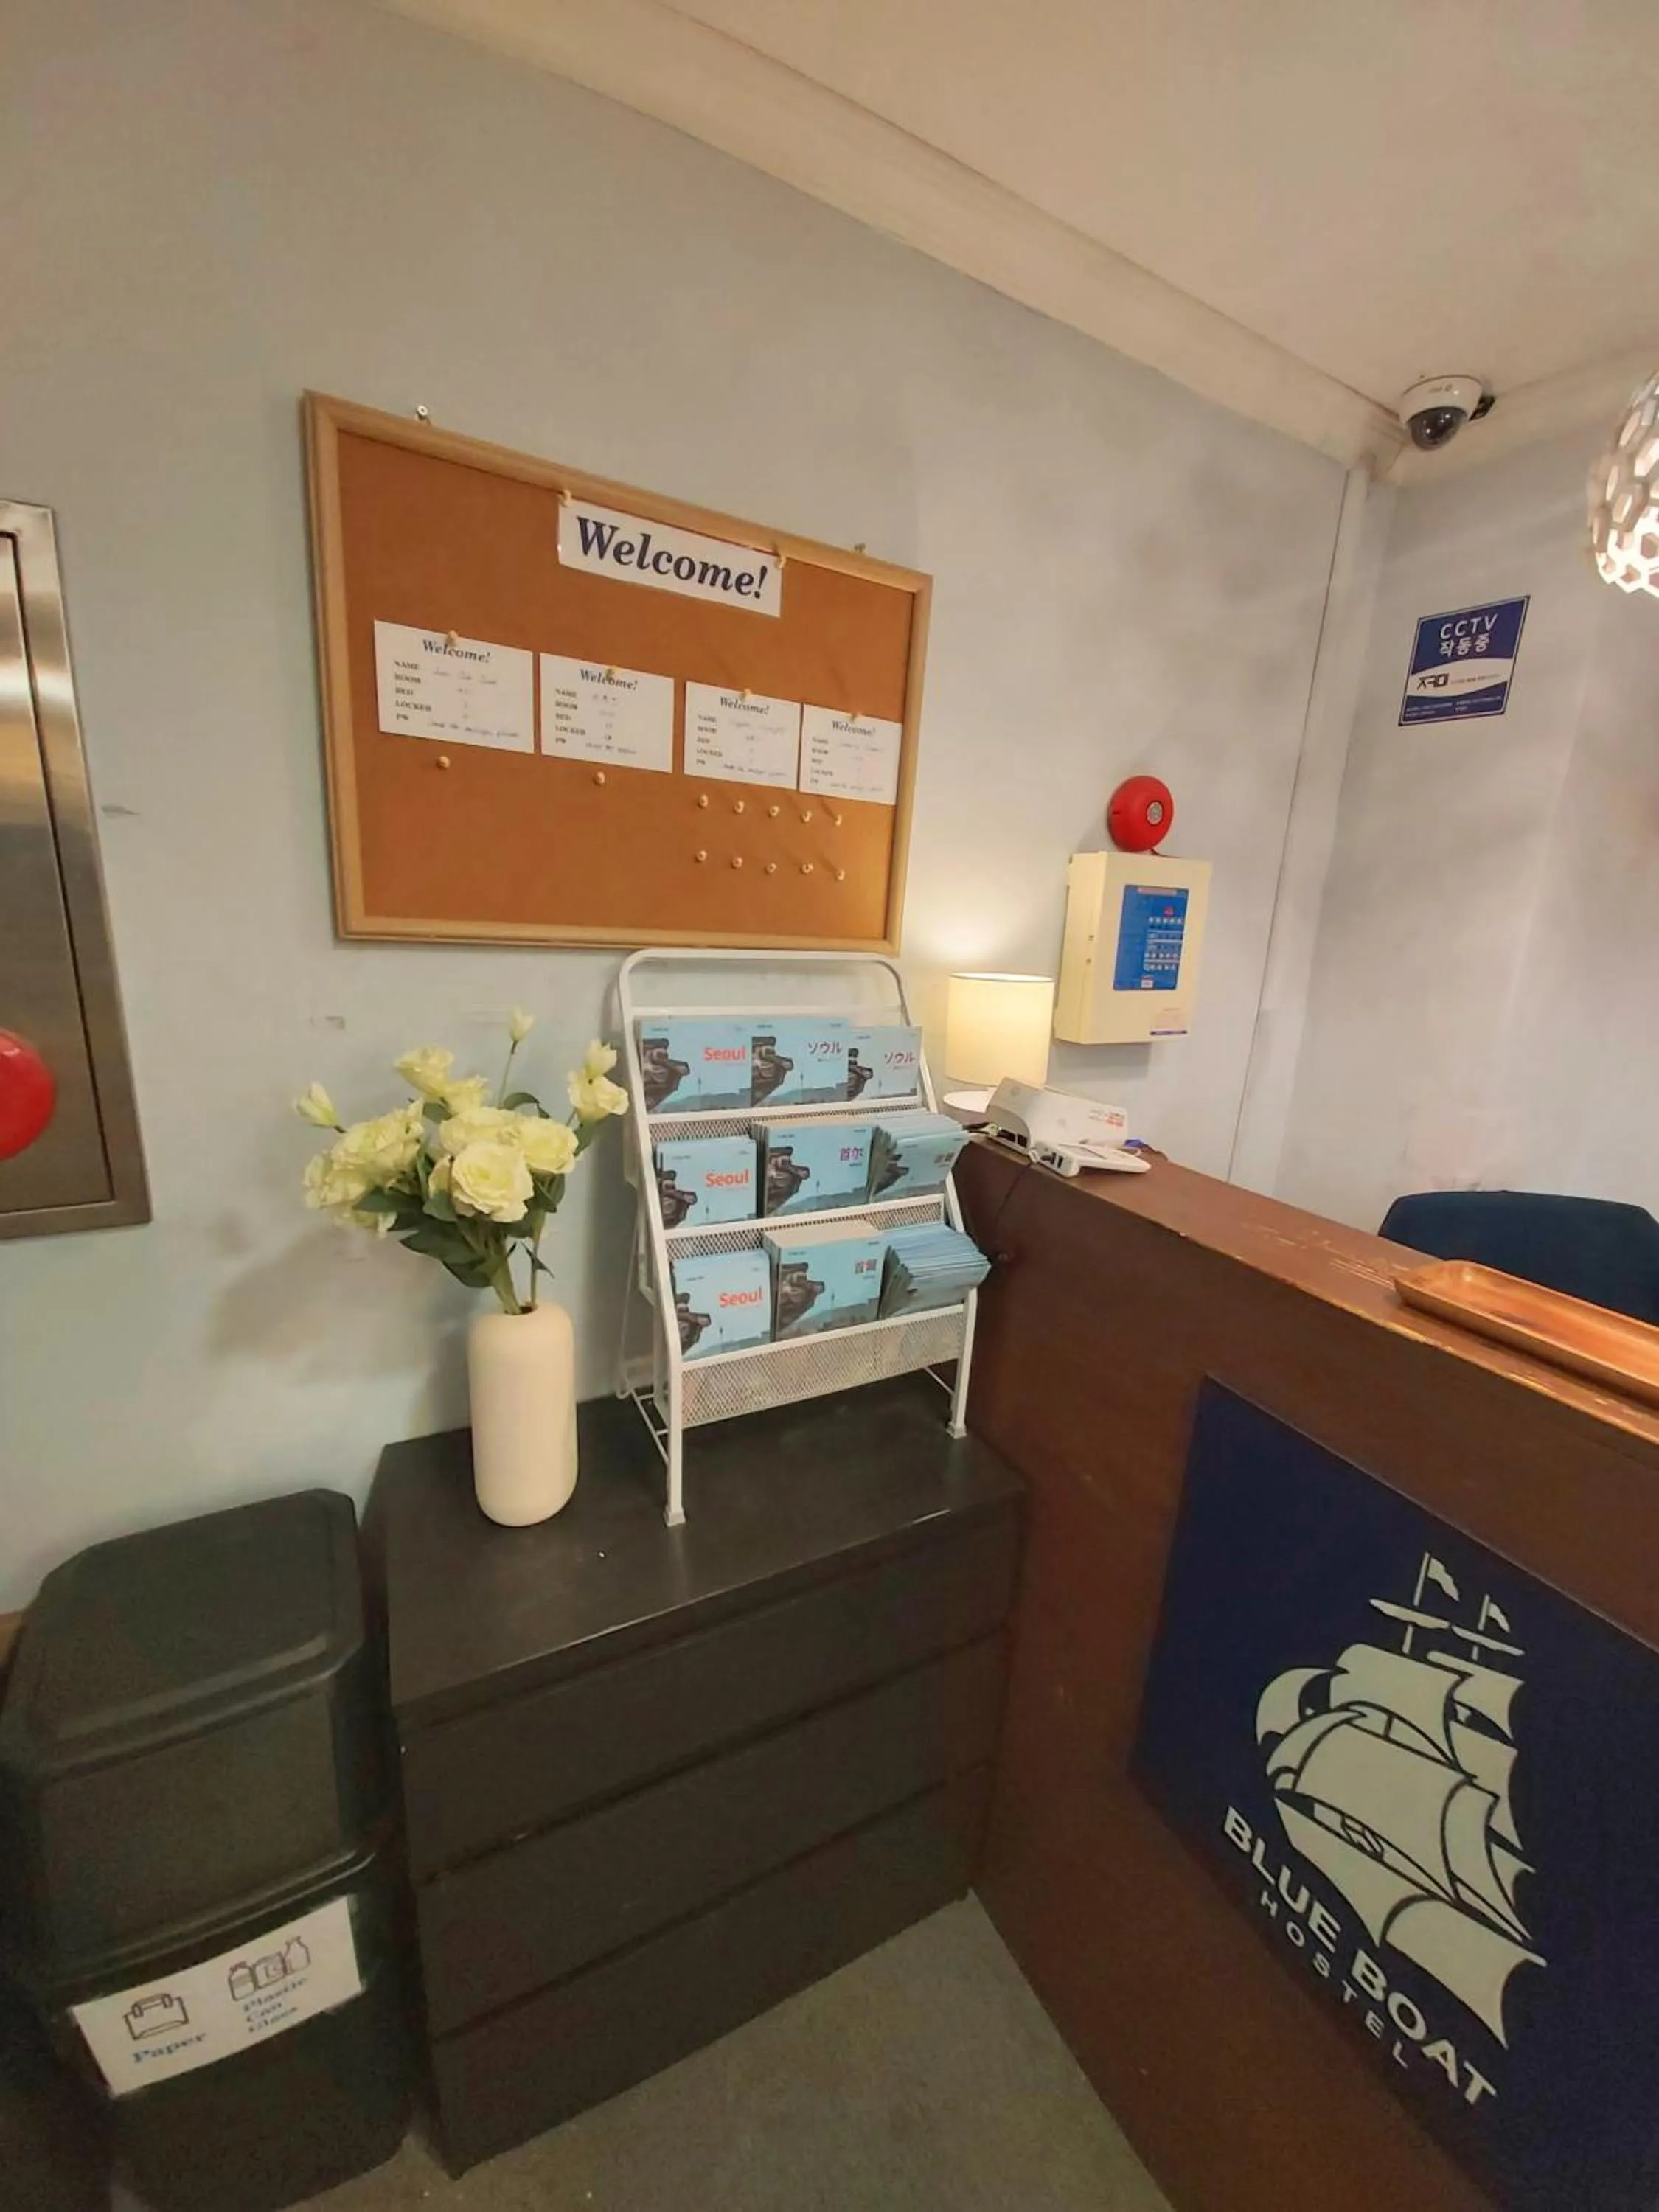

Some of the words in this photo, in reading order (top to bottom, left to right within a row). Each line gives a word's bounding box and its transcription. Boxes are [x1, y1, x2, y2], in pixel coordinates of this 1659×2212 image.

[576, 516, 768, 599] Welcome!
[1439, 613, 1499, 639] CCTV
[422, 639, 491, 663] Welcome!
[1439, 633, 1490, 658] 작동중
[580, 669, 639, 690] Welcome!
[720, 696, 771, 714] Welcome!
[703, 1046, 746, 1062] Seoul
[807, 1040, 843, 1055] ソウル
[884, 1051, 916, 1063] ソウル
[705, 1170, 750, 1188] Seoul
[719, 1286, 764, 1307] Seoul
[1222, 1806, 1342, 1953] BLUE
[1352, 1949, 1498, 2105] BOAT
[1260, 1891, 1408, 2069] HOSTEL
[133, 2032, 207, 2064] Paper
